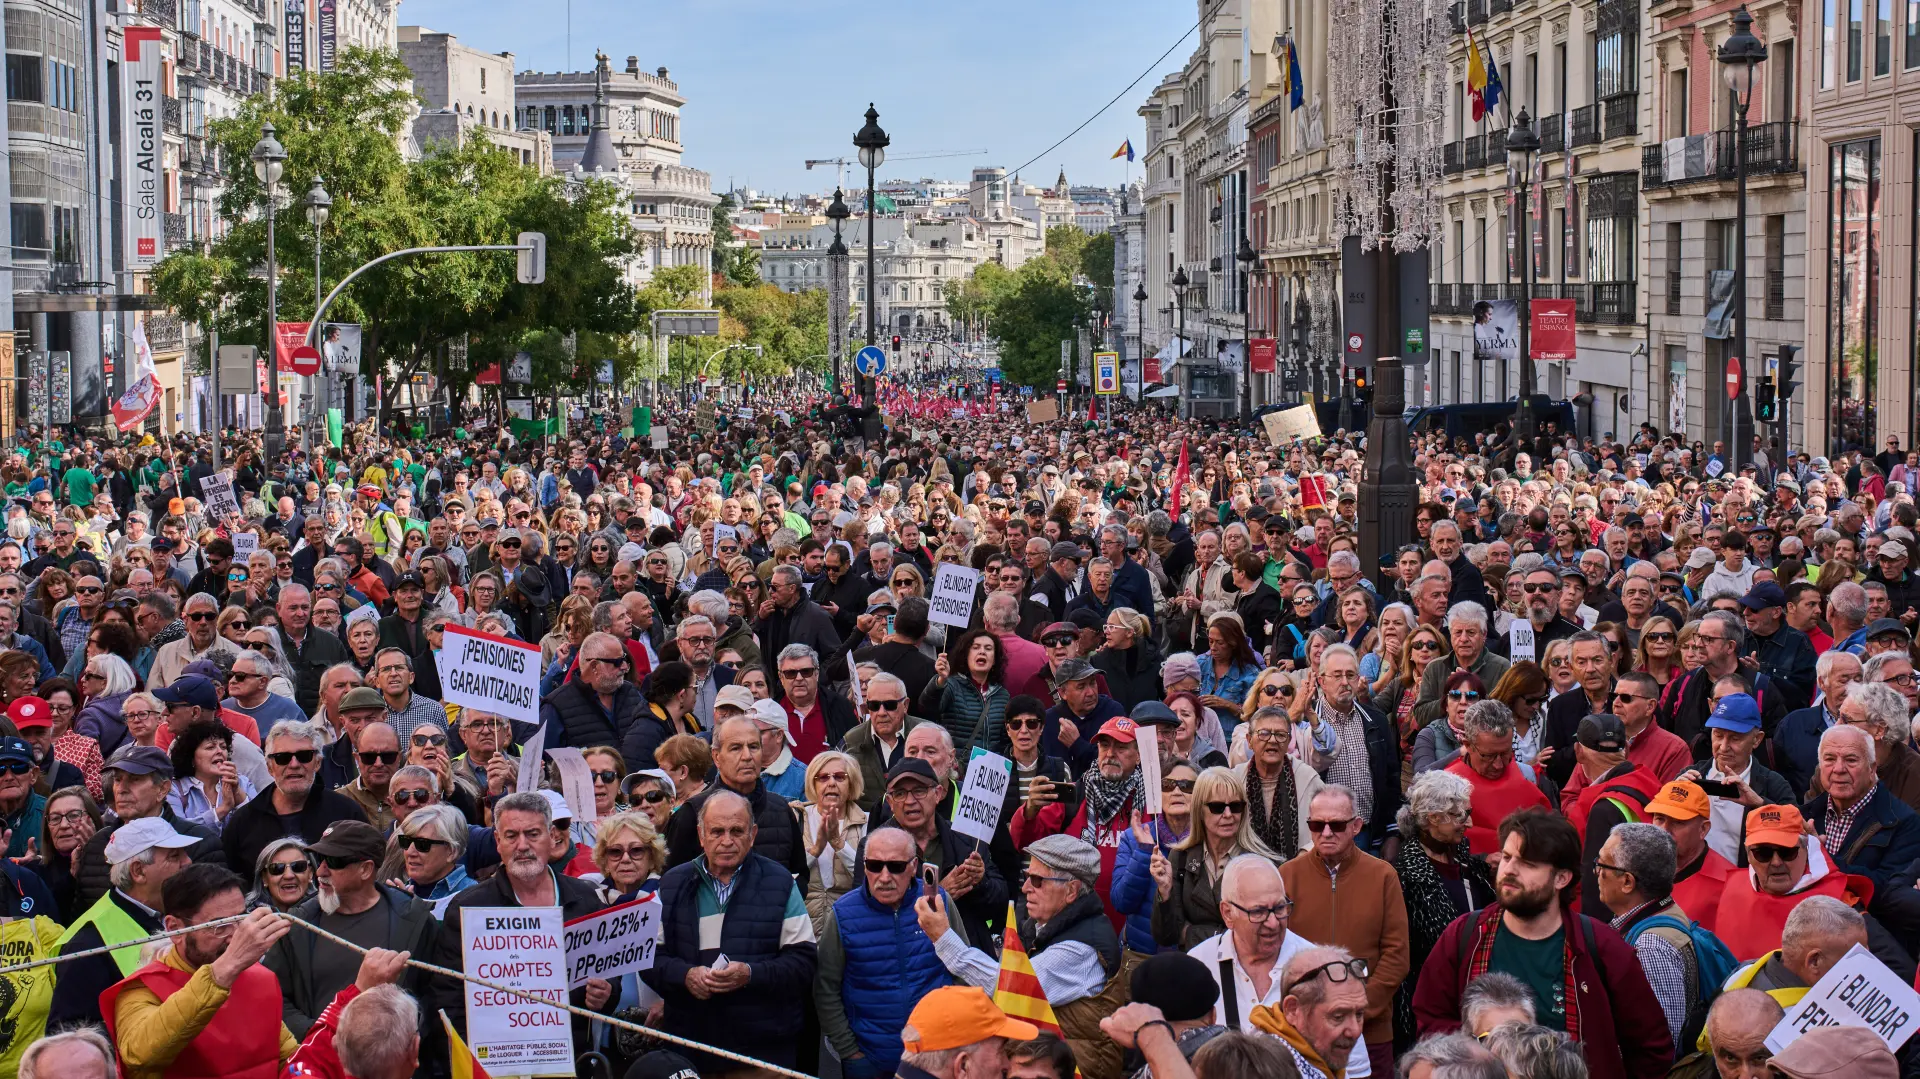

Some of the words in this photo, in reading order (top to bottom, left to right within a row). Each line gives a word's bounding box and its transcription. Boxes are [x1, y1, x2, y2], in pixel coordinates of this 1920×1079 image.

[322, 13, 335, 36] VIVAS
[135, 79, 153, 102] 31
[135, 108, 155, 173] Alcalá
[137, 179, 155, 220] Sala
[1476, 338, 1518, 350] YERMA
[207, 475, 218, 485] LA
[214, 494, 224, 502] ES
[943, 573, 973, 594] BLINDAR
[932, 596, 971, 618] PENSIONES!
[462, 638, 526, 674] ¡PENSIONES
[450, 669, 534, 710] GARANTIZADAS!
[975, 765, 1006, 796] BLINDAR
[486, 917, 541, 930] EXIGIM
[472, 935, 558, 950] AUDITORIA
[574, 937, 654, 980] PPensión?
[478, 962, 553, 979] COMPTES
[473, 989, 564, 1007] SEGURETAT
[1838, 973, 1910, 1041] BLINDAR
[508, 1011, 564, 1028] SOCIAL
